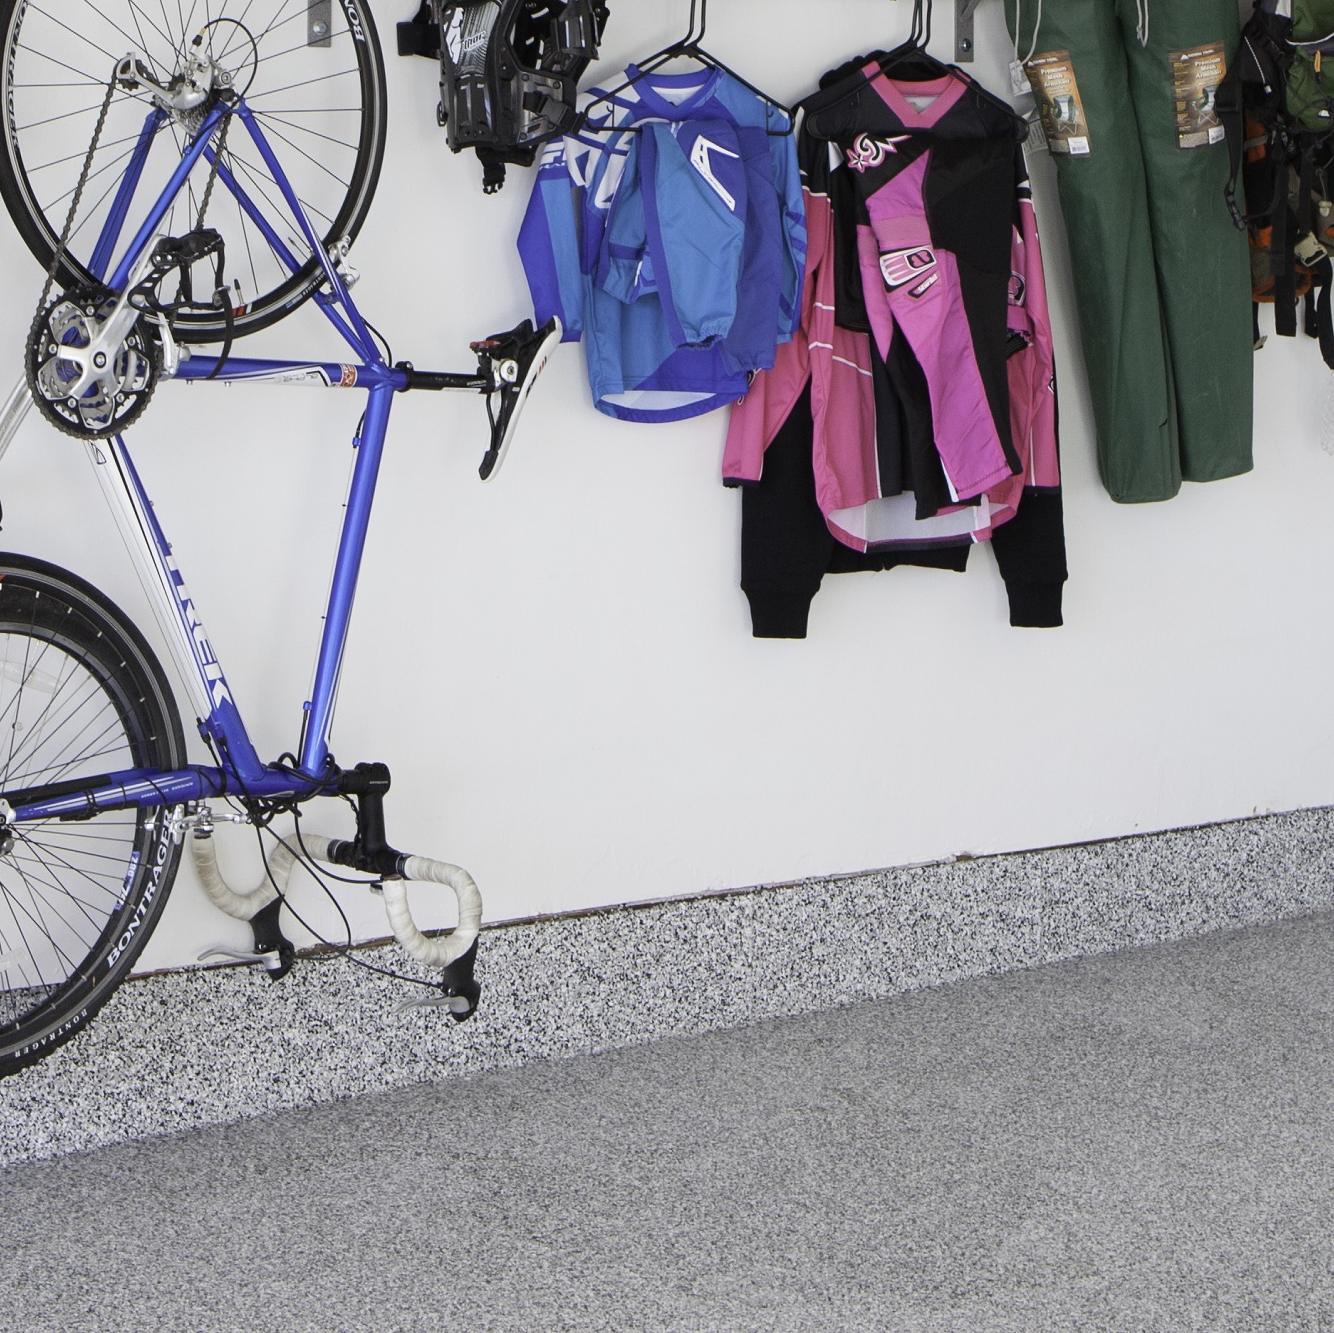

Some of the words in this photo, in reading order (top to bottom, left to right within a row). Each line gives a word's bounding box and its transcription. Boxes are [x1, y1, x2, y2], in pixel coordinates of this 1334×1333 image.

[463, 31, 487, 51] thor
[1040, 66, 1068, 75] Premium
[107, 809, 174, 968] BONTRAGER
[14, 1008, 87, 1058] BONTRAGER
